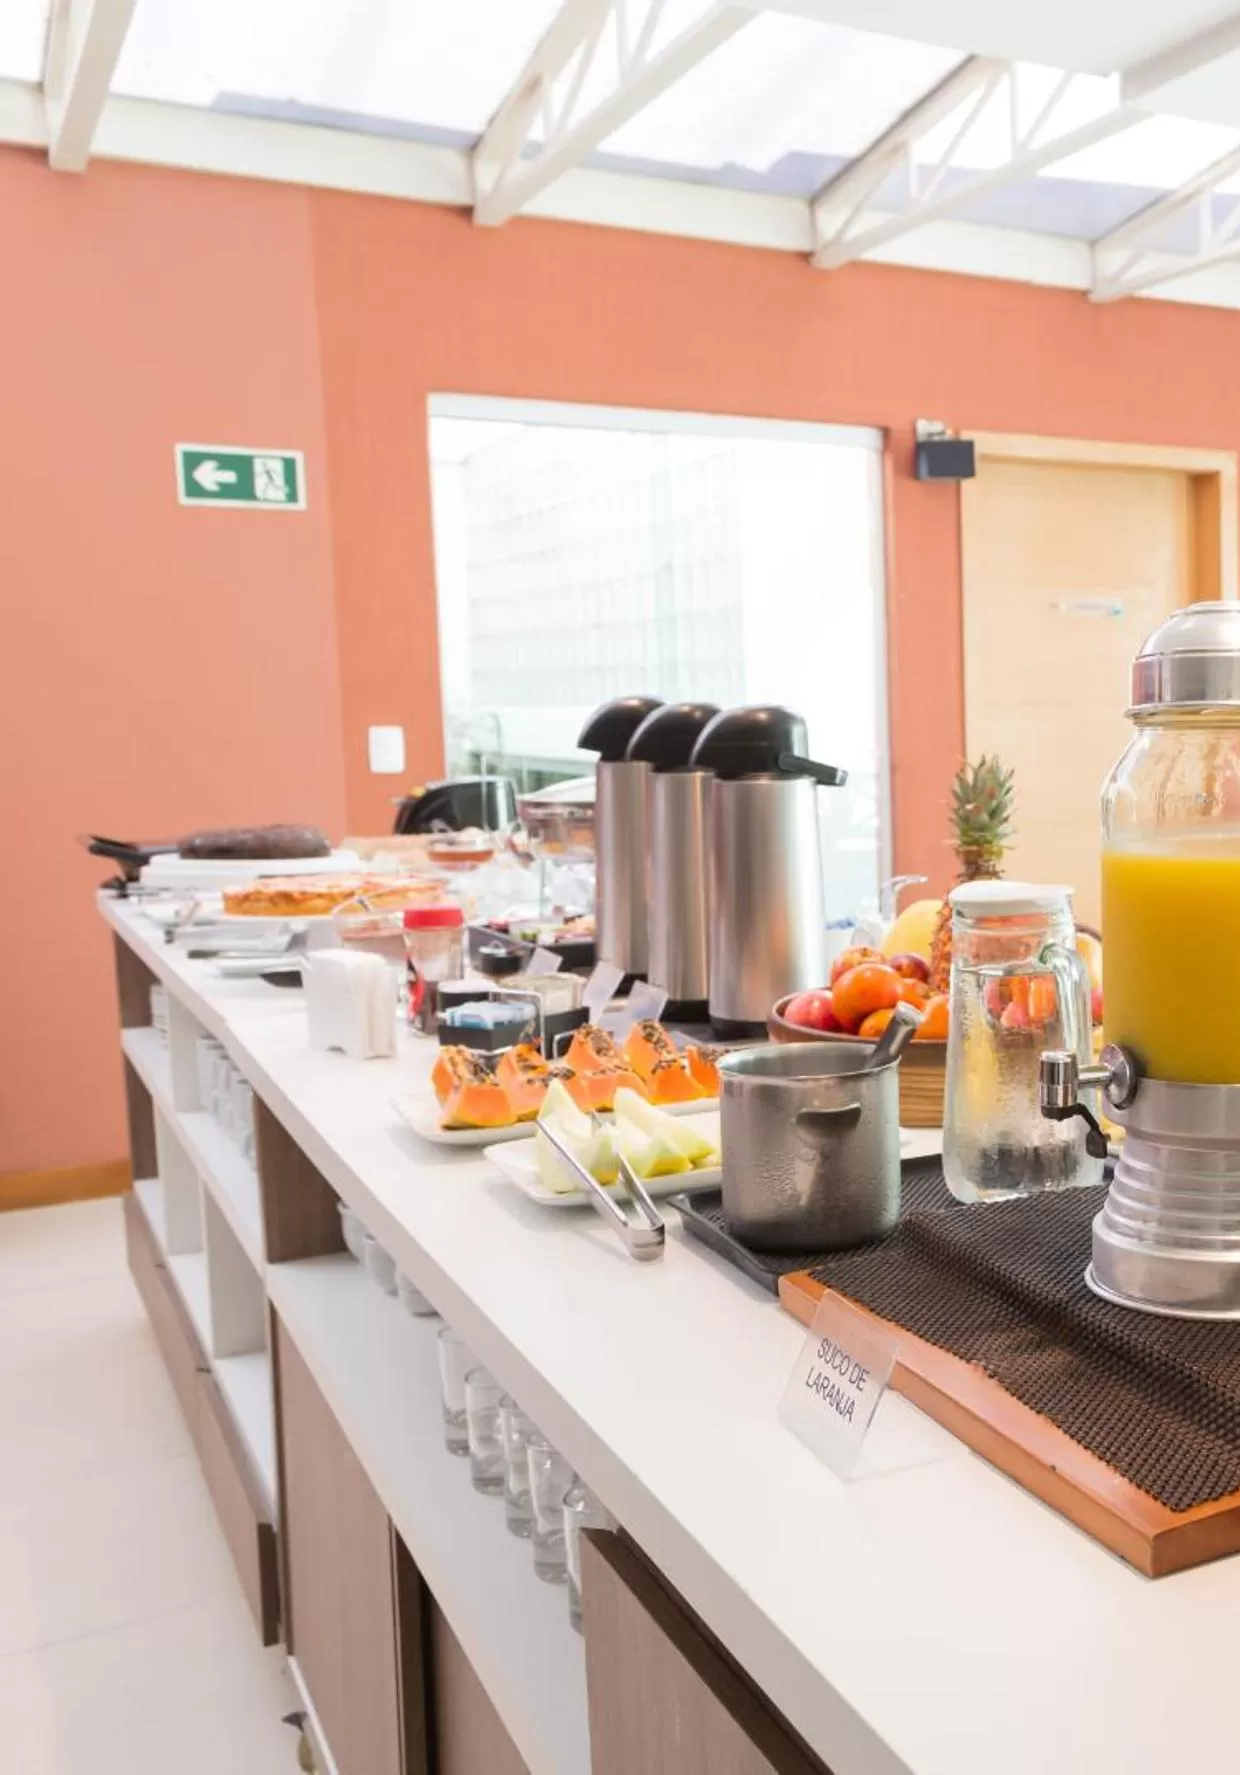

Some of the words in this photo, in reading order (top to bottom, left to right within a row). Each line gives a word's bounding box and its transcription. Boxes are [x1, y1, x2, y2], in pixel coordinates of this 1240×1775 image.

[817, 1337, 850, 1377] SUCO
[848, 1363, 870, 1392] DE
[805, 1366, 856, 1423] LARANJA
